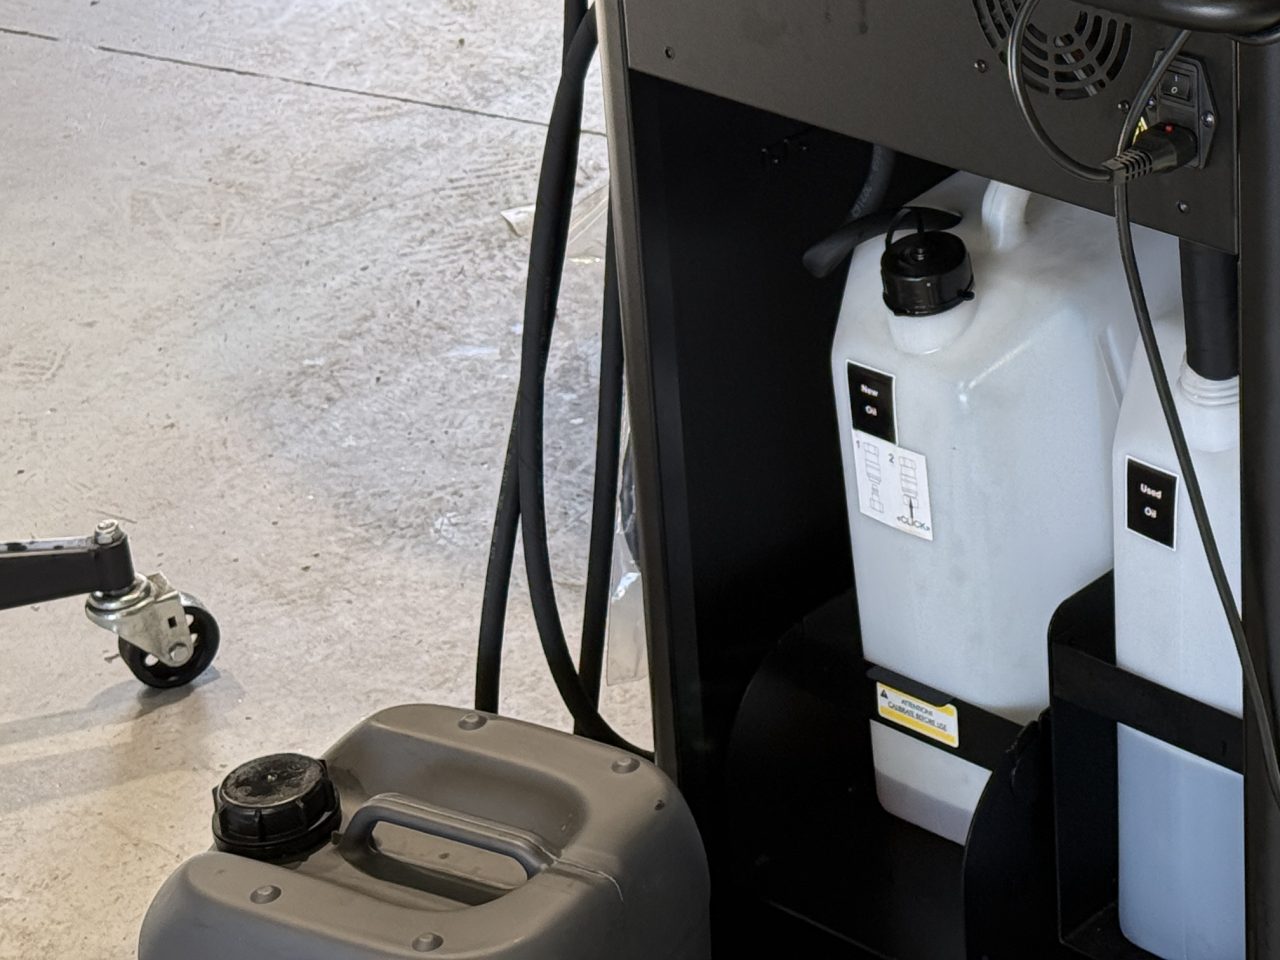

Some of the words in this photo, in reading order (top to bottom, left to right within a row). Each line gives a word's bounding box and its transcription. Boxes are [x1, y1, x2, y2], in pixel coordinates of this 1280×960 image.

[860, 383, 879, 397] New
[865, 404, 878, 417] Oil
[856, 440, 861, 449] 1
[888, 453, 895, 464] 2
[1140, 482, 1162, 500] Used
[1144, 506, 1157, 519] Oil
